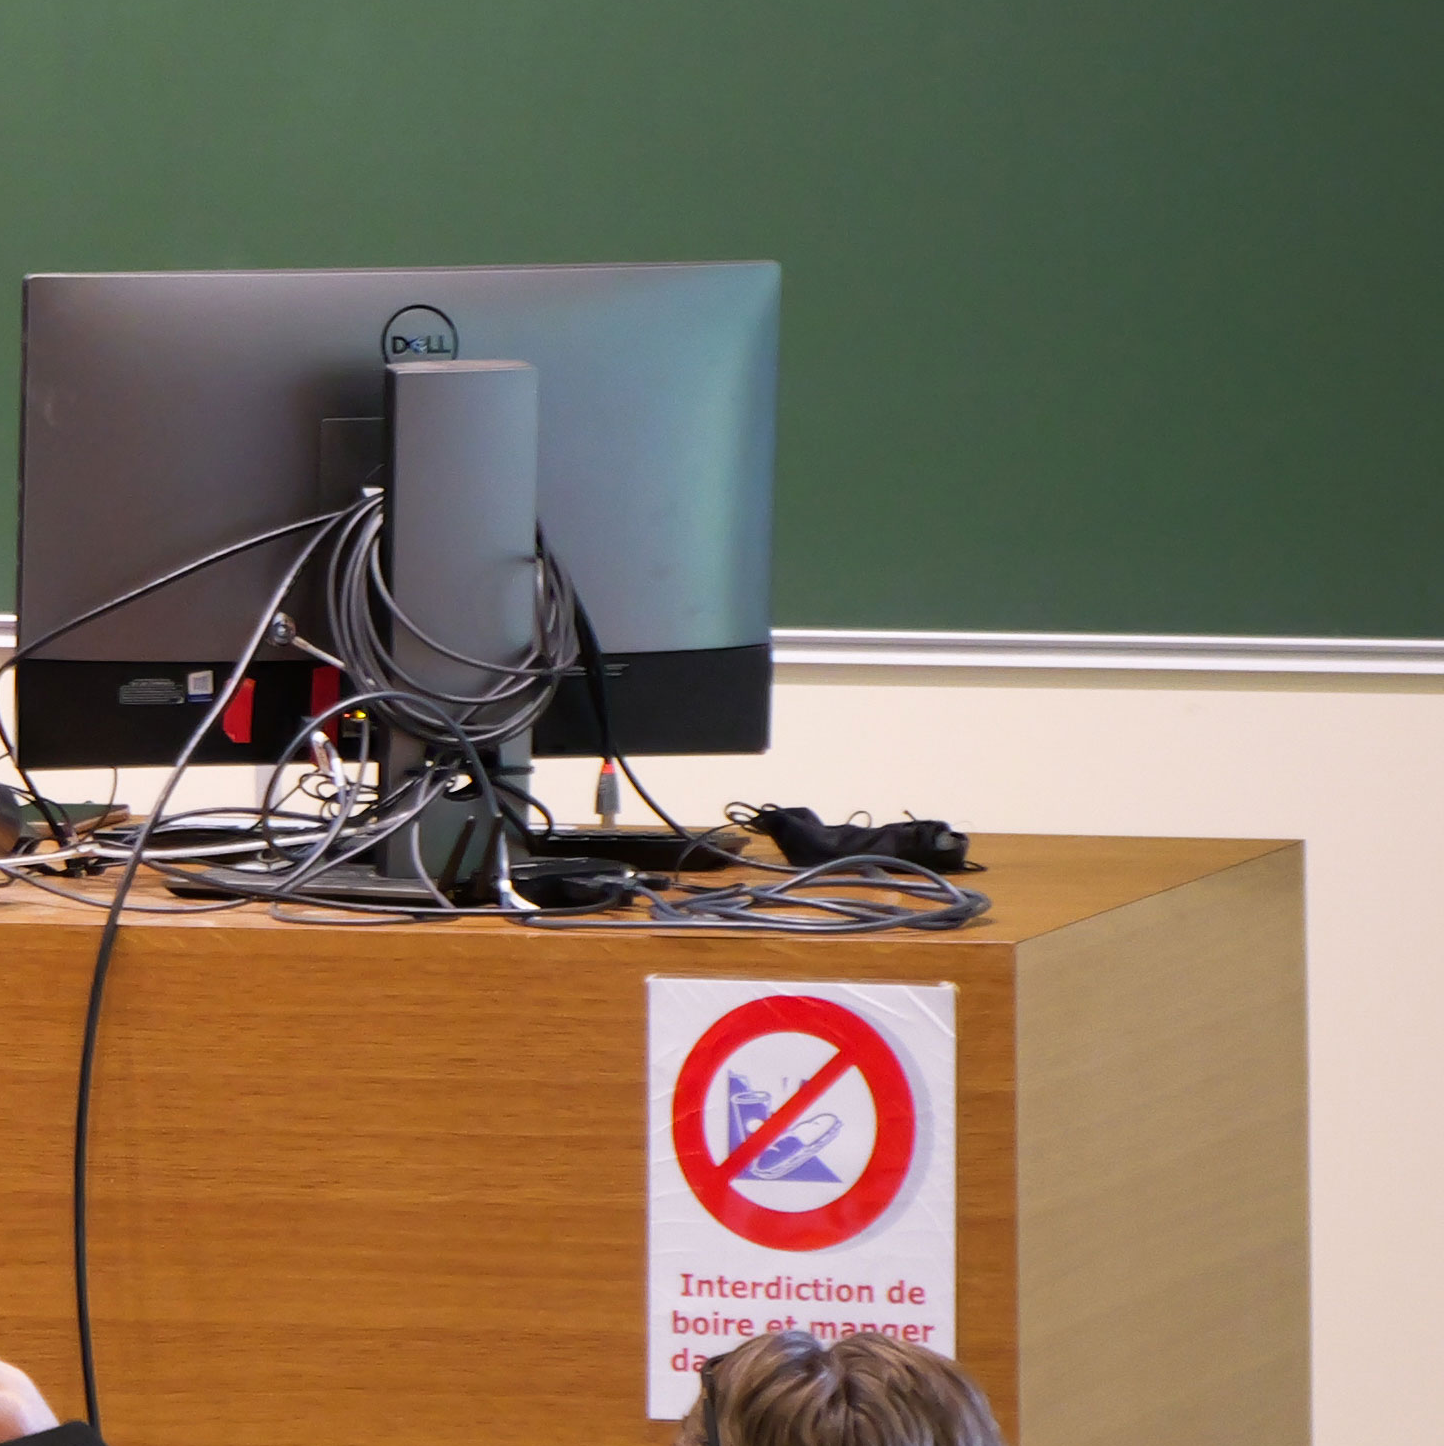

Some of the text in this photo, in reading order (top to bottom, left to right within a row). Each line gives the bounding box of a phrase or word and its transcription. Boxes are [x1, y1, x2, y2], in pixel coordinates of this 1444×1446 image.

[392, 335, 452, 354] DELL
[680, 1273, 926, 1305] Interdiction de
[672, 1310, 755, 1337] boire
[671, 1348, 709, 1372] da
